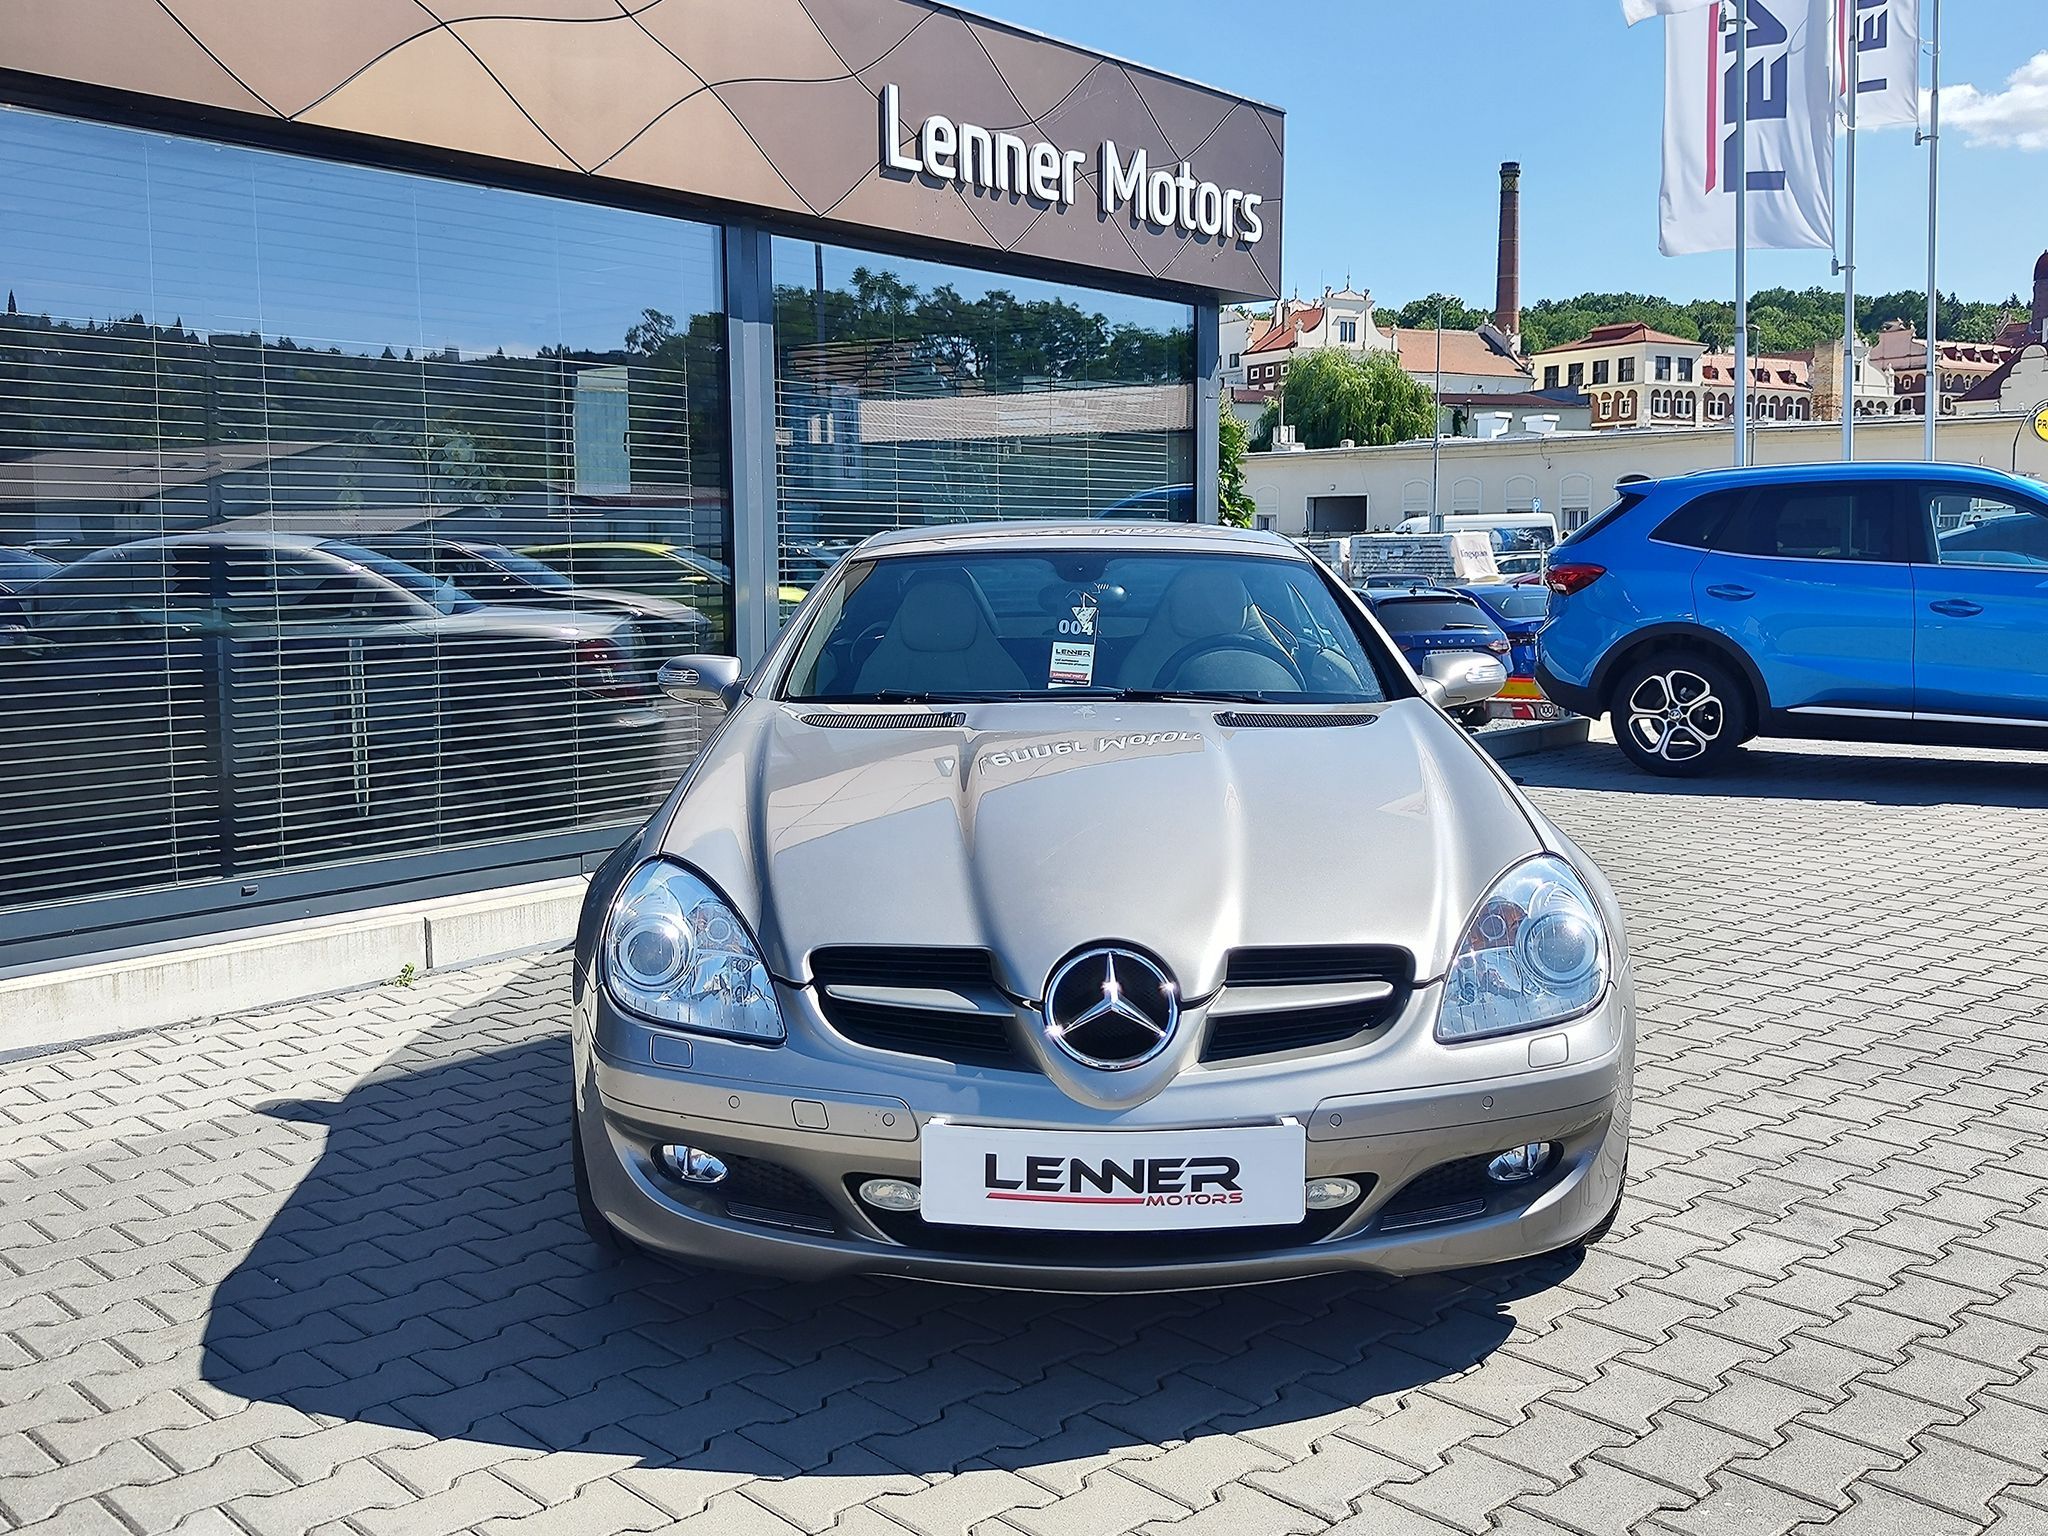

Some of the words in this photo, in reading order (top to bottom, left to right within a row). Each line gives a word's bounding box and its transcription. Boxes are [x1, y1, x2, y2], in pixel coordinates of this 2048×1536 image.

[882, 82, 1087, 206] Lenner
[1101, 139, 1263, 243] Motors
[1058, 619, 1094, 636] 004
[1055, 648, 1091, 657] LENNER
[984, 1153, 1243, 1194] LENNER
[1145, 1192, 1244, 1207] MOTORS
